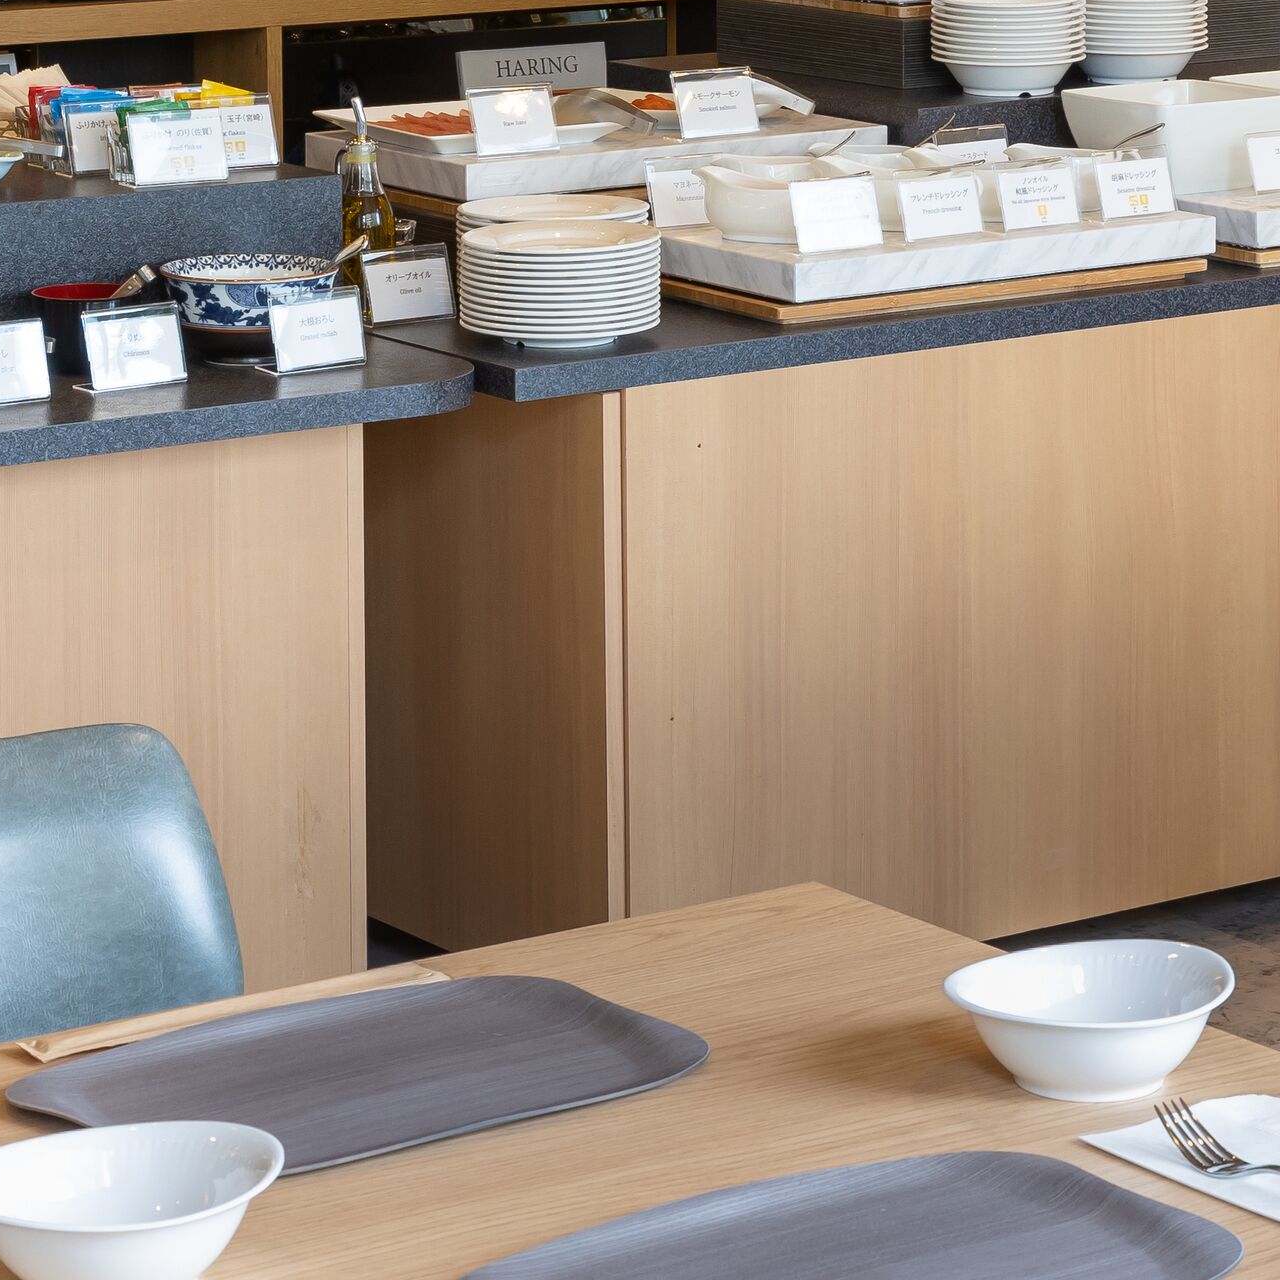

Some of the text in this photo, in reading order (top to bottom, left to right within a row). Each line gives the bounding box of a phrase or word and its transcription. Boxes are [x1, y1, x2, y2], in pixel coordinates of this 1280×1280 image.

[495, 55, 578, 78] HARING
[692, 89, 741, 100] スモークサーモン
[699, 105, 719, 113] Smoked
[1023, 176, 1048, 184] ノンオイル
[1111, 169, 1157, 182] 胡麻ドレッシング
[910, 187, 968, 203] フレンチドレッシング
[385, 270, 432, 283] オリーブオイル
[399, 286, 422, 296] Olive oil
[298, 315, 335, 327] 大根おろし
